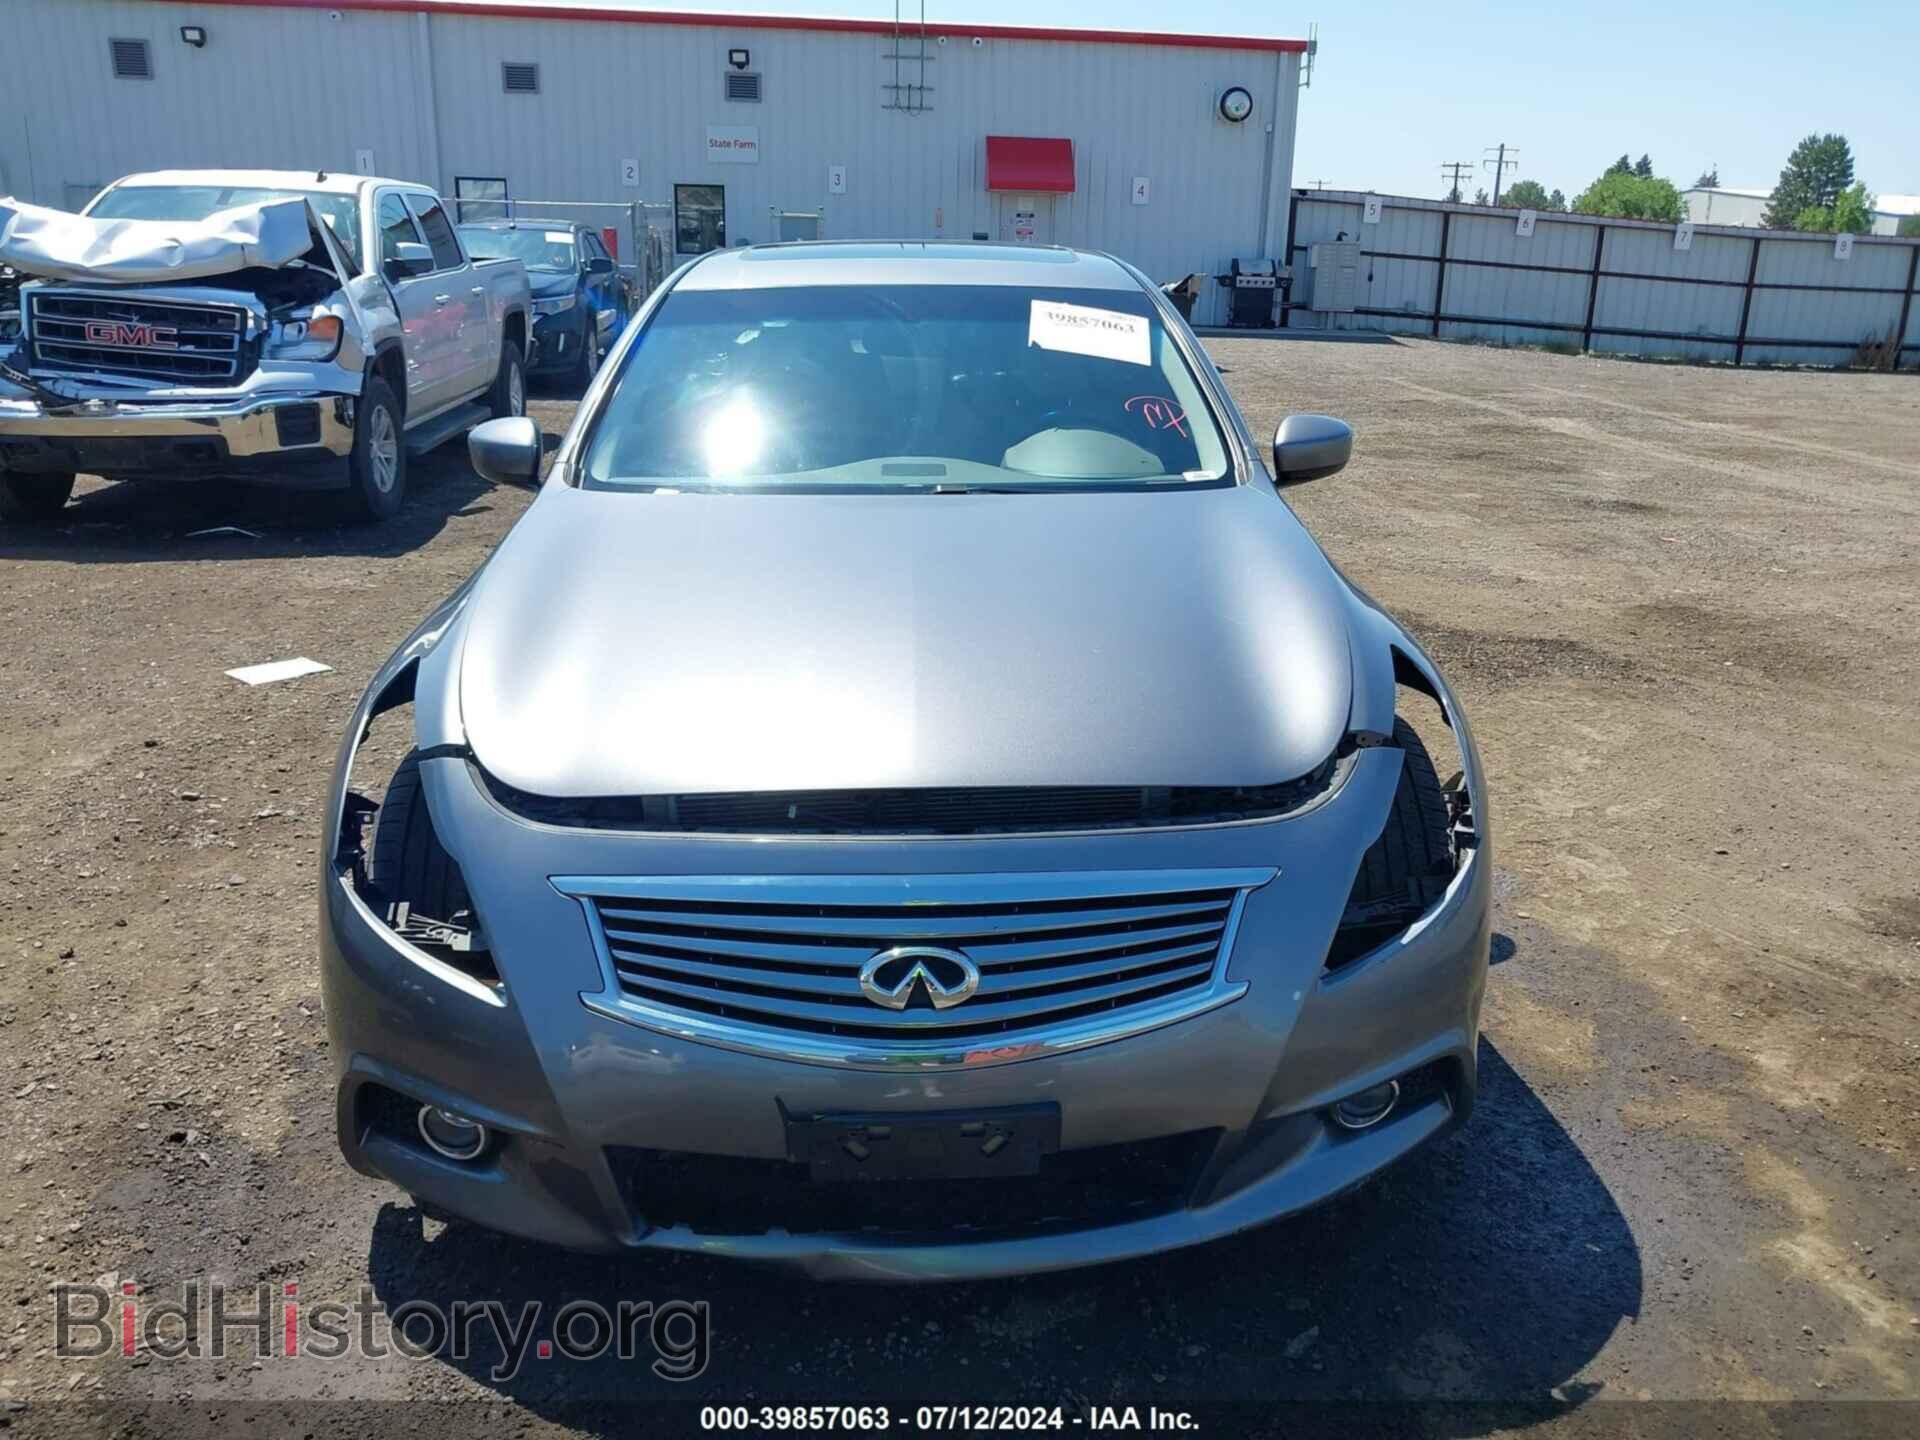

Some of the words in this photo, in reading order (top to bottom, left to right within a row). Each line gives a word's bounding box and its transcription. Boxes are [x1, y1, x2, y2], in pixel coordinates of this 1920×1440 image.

[709, 138, 731, 149] State
[733, 139, 756, 150] Farm
[626, 166, 634, 179] 2
[834, 173, 841, 186] 3
[1137, 184, 1145, 198] 4
[1369, 203, 1376, 216] 5
[1522, 217, 1529, 229] 6
[1680, 231, 1688, 242] 7
[84, 321, 179, 350] GMC
